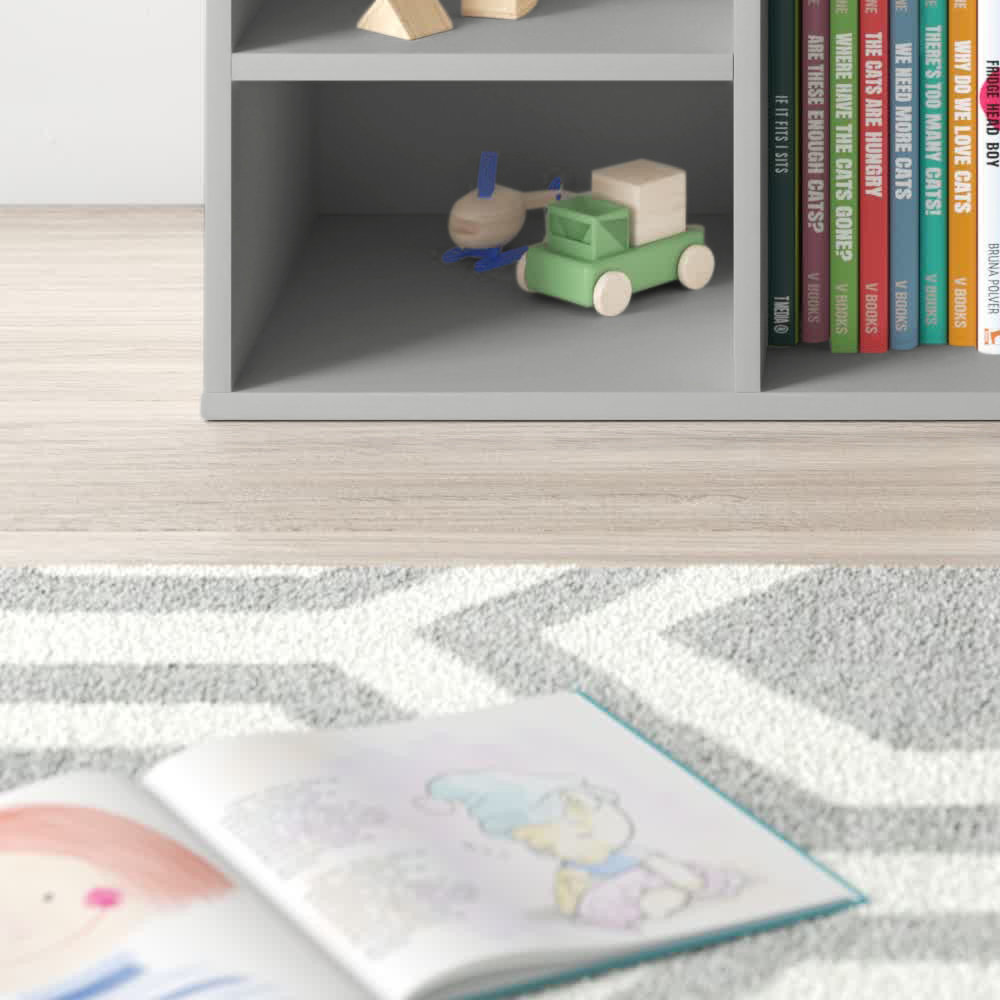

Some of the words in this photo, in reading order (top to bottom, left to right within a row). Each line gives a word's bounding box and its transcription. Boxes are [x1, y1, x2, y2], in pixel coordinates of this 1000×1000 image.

[807, 35, 824, 60] ARE
[835, 33, 852, 79] WHERE
[865, 32, 882, 56] THE
[895, 42, 912, 63] WE
[925, 25, 942, 78] THERE'S
[954, 40, 972, 71] WHY
[807, 64, 824, 105] THESE
[865, 60, 882, 95] CATS
[895, 67, 912, 102] NEED
[925, 82, 942, 108] TOO
[954, 75, 972, 94] DO
[986, 60, 1000, 98] FRIDGE
[775, 95, 788, 104] IF
[775, 108, 788, 116] IT
[835, 83, 852, 119] HAVE
[865, 98, 882, 126] ARE
[954, 98, 972, 121] WE
[775, 121, 788, 142] FITS
[895, 106, 912, 152] MORE
[986, 103, 1000, 135] HEAD
[807, 110, 824, 173] ENOUGH
[835, 123, 852, 153] THE
[925, 113, 942, 161] MANY
[954, 126, 972, 165] LOVE
[986, 142, 1000, 167] BOY
[775, 152, 788, 174] SITS
[835, 158, 852, 200] CATS
[865, 131, 882, 197] HUNGRY
[895, 157, 912, 200] CATS
[807, 179, 824, 233] CATS?
[925, 167, 942, 215] CATS!
[954, 170, 972, 213] CATS
[835, 206, 852, 262] GONE?
[807, 272, 820, 280] V
[988, 243, 1000, 277] BRUNA
[835, 283, 848, 292] V
[865, 282, 877, 291] V
[895, 280, 907, 288] V
[925, 274, 937, 282] V
[954, 277, 967, 285] V
[807, 284, 820, 323] BOOKS
[865, 294, 877, 334] BOOKS
[895, 292, 907, 331] BOOKS
[925, 285, 937, 325] BOOKS
[954, 288, 967, 328] BOOKS
[988, 279, 1000, 314] POLVER
[835, 295, 848, 335] BOOKS
